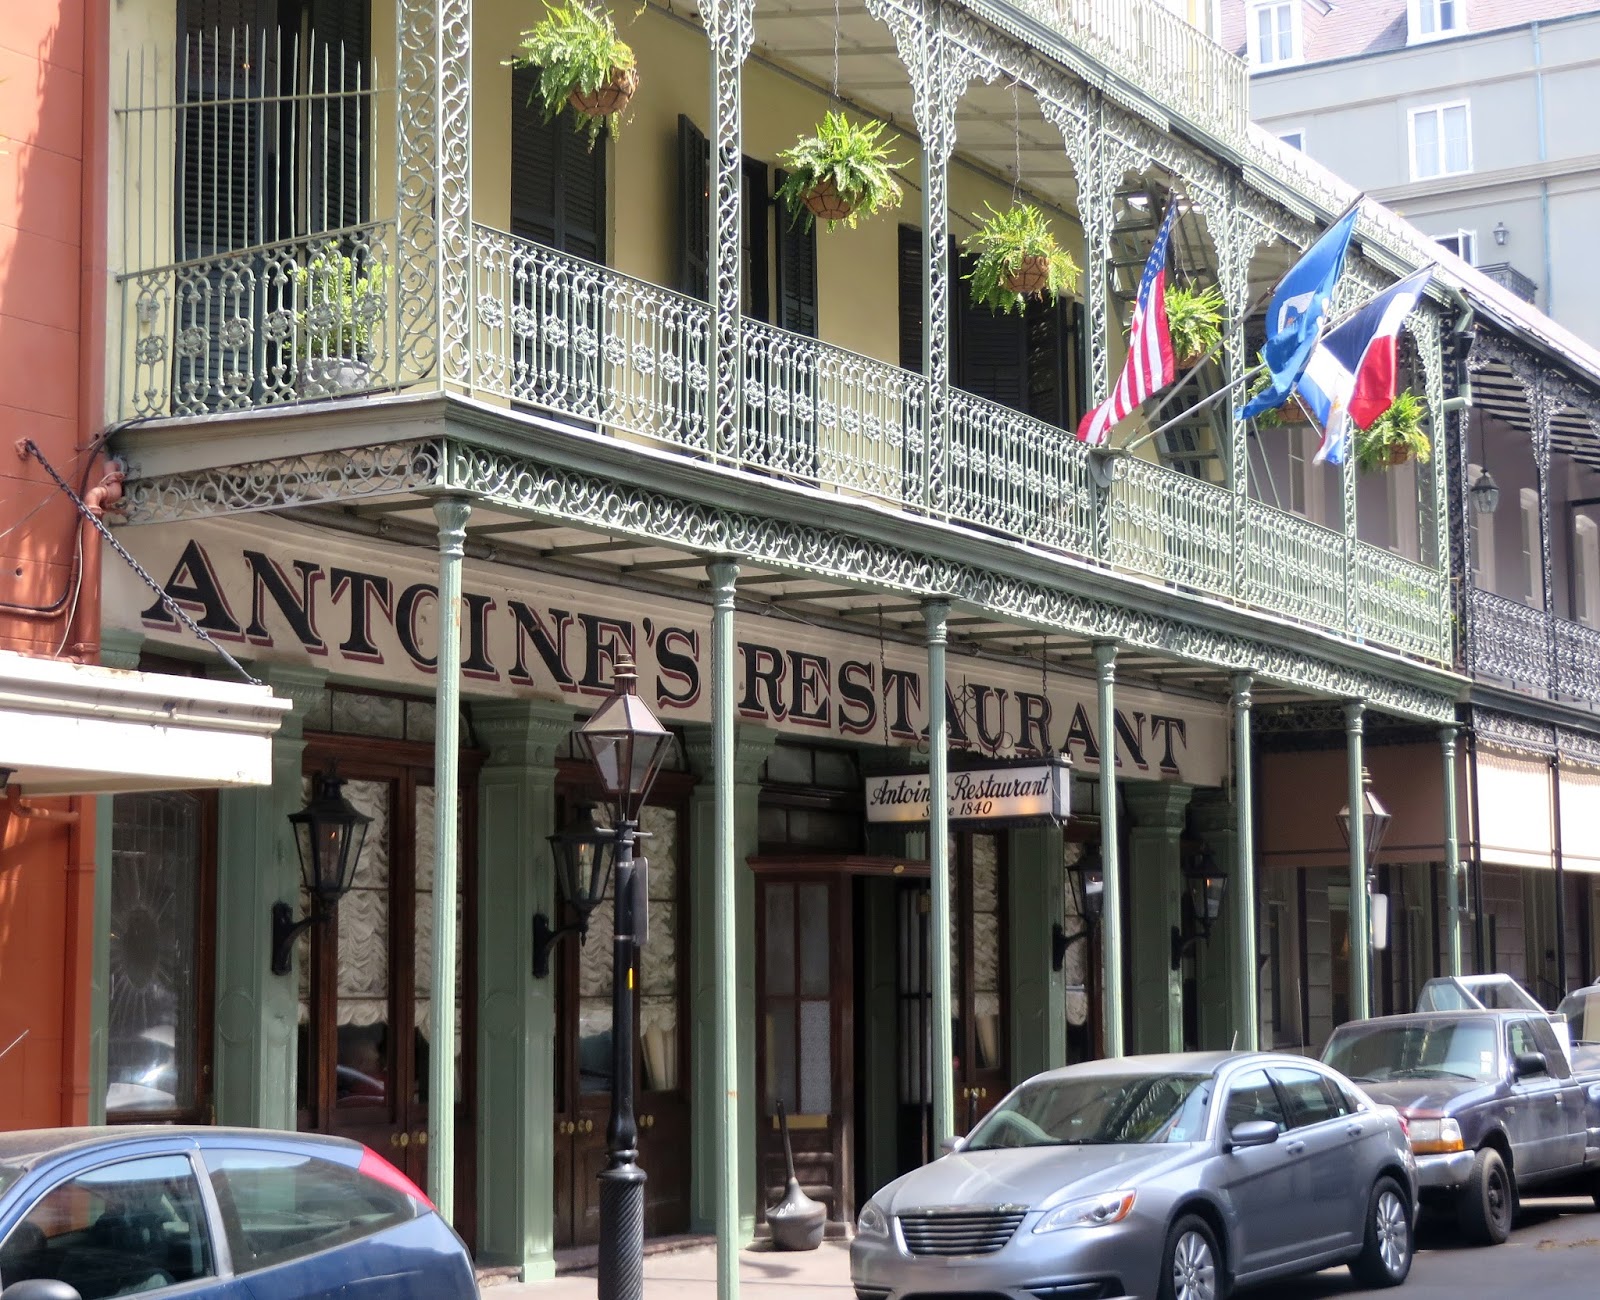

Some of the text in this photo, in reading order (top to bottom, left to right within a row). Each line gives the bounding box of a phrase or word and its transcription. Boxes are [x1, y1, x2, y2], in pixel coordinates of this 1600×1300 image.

[141, 539, 1187, 774] ANTOINE'S RESTAURANT
[870, 772, 1050, 806] Antoin Restaurant
[960, 800, 993, 815] 1840
